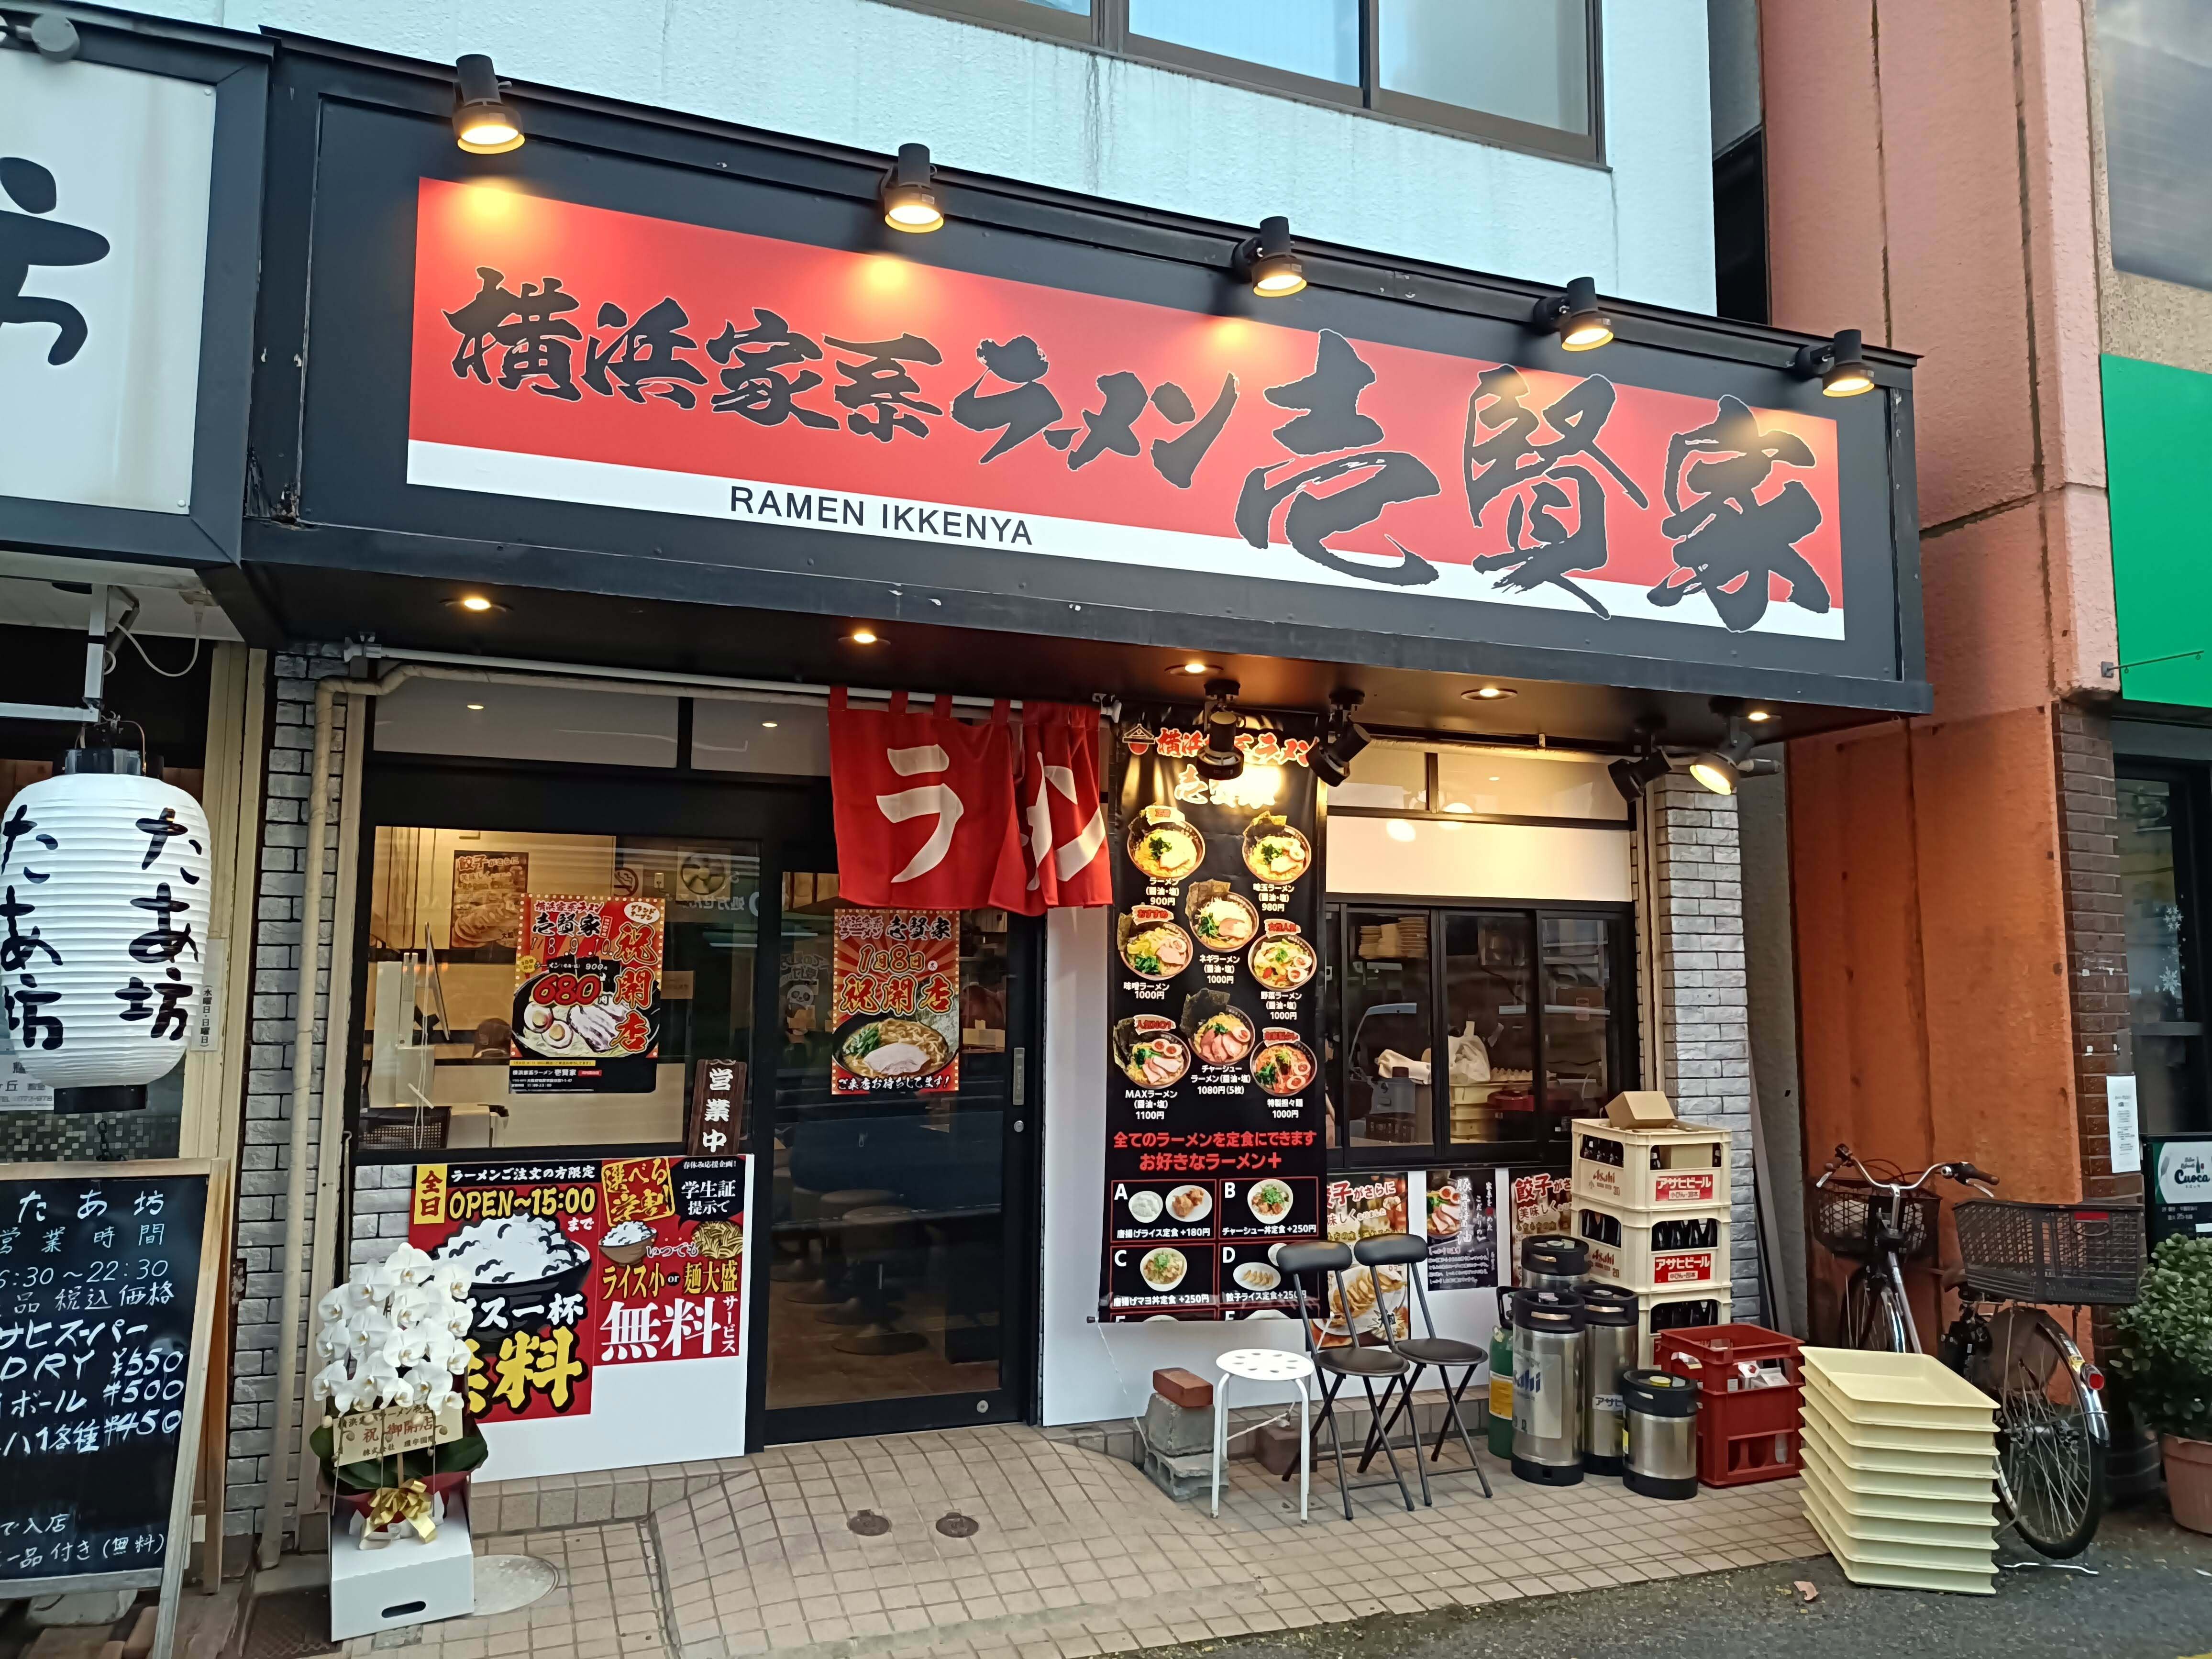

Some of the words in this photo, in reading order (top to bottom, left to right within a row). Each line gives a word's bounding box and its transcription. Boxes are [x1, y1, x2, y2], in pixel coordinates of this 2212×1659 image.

[443, 266, 1239, 489] 横浜家系ラーメン
[1235, 328, 1831, 632] 壱賢家
[730, 486, 863, 526] RAMEN
[883, 498, 1033, 545] IKKENYA
[1149, 877, 1180, 886] ラーメン
[1150, 896, 1176, 906] 900円
[1261, 903, 1285, 912] 980円
[1137, 909, 1169, 919] おすすめ
[115, 807, 202, 1040] たあ坊
[532, 912, 602, 937] 壱賢家
[886, 914, 951, 940] 壱賢家
[858, 943, 926, 974] 1月8日
[1199, 955, 1240, 964] ネギラーメン
[610, 921, 660, 1052] 祝開店
[1206, 975, 1234, 984] 1000円
[839, 973, 954, 1016] 祝開店
[1134, 991, 1165, 1000] 1000円
[1270, 1011, 1297, 1020] 1000円
[1125, 1089, 1178, 1099] MAXラーメン
[702, 1068, 733, 1153] 営業中
[1135, 1111, 1164, 1120] 1100円
[1272, 1110, 1299, 1119] 1000円
[1113, 1130, 1317, 1148] 全てのラーメンを定食にできます
[451, 1165, 595, 1183] ラーメンご注文の方限定
[605, 1158, 668, 1194] 選べる
[1593, 1169, 1615, 1183] Asahi
[2174, 1169, 2210, 1184] Cuoca
[681, 1179, 736, 1199] 学生証
[1224, 1182, 1236, 1198] B
[1657, 1176, 1712, 1190] アサヒビール
[420, 1170, 443, 1217] 全日
[1114, 1183, 1128, 1200] A
[18, 1190, 164, 1223] たあ坊
[567, 1217, 594, 1232] まで
[1180, 1228, 1210, 1237] +180円
[1287, 1224, 1316, 1234] +250円
[0, 1223, 165, 1254] 営業時間
[646, 1242, 699, 1258] いつでも
[1222, 1247, 1236, 1263] D
[1592, 1249, 1615, 1265] Asahi
[1114, 1250, 1127, 1267] C
[1656, 1255, 1710, 1271] アサヒビール
[602, 1262, 665, 1300] ライス小
[668, 1275, 680, 1283] or
[683, 1260, 738, 1294] 麺大盛
[1179, 1294, 1209, 1304] +250円
[599, 1296, 721, 1361] 無料
[721, 1295, 739, 1353] サービス
[0, 1349, 95, 1381] DRY
[363, 1427, 379, 1442] 祝
